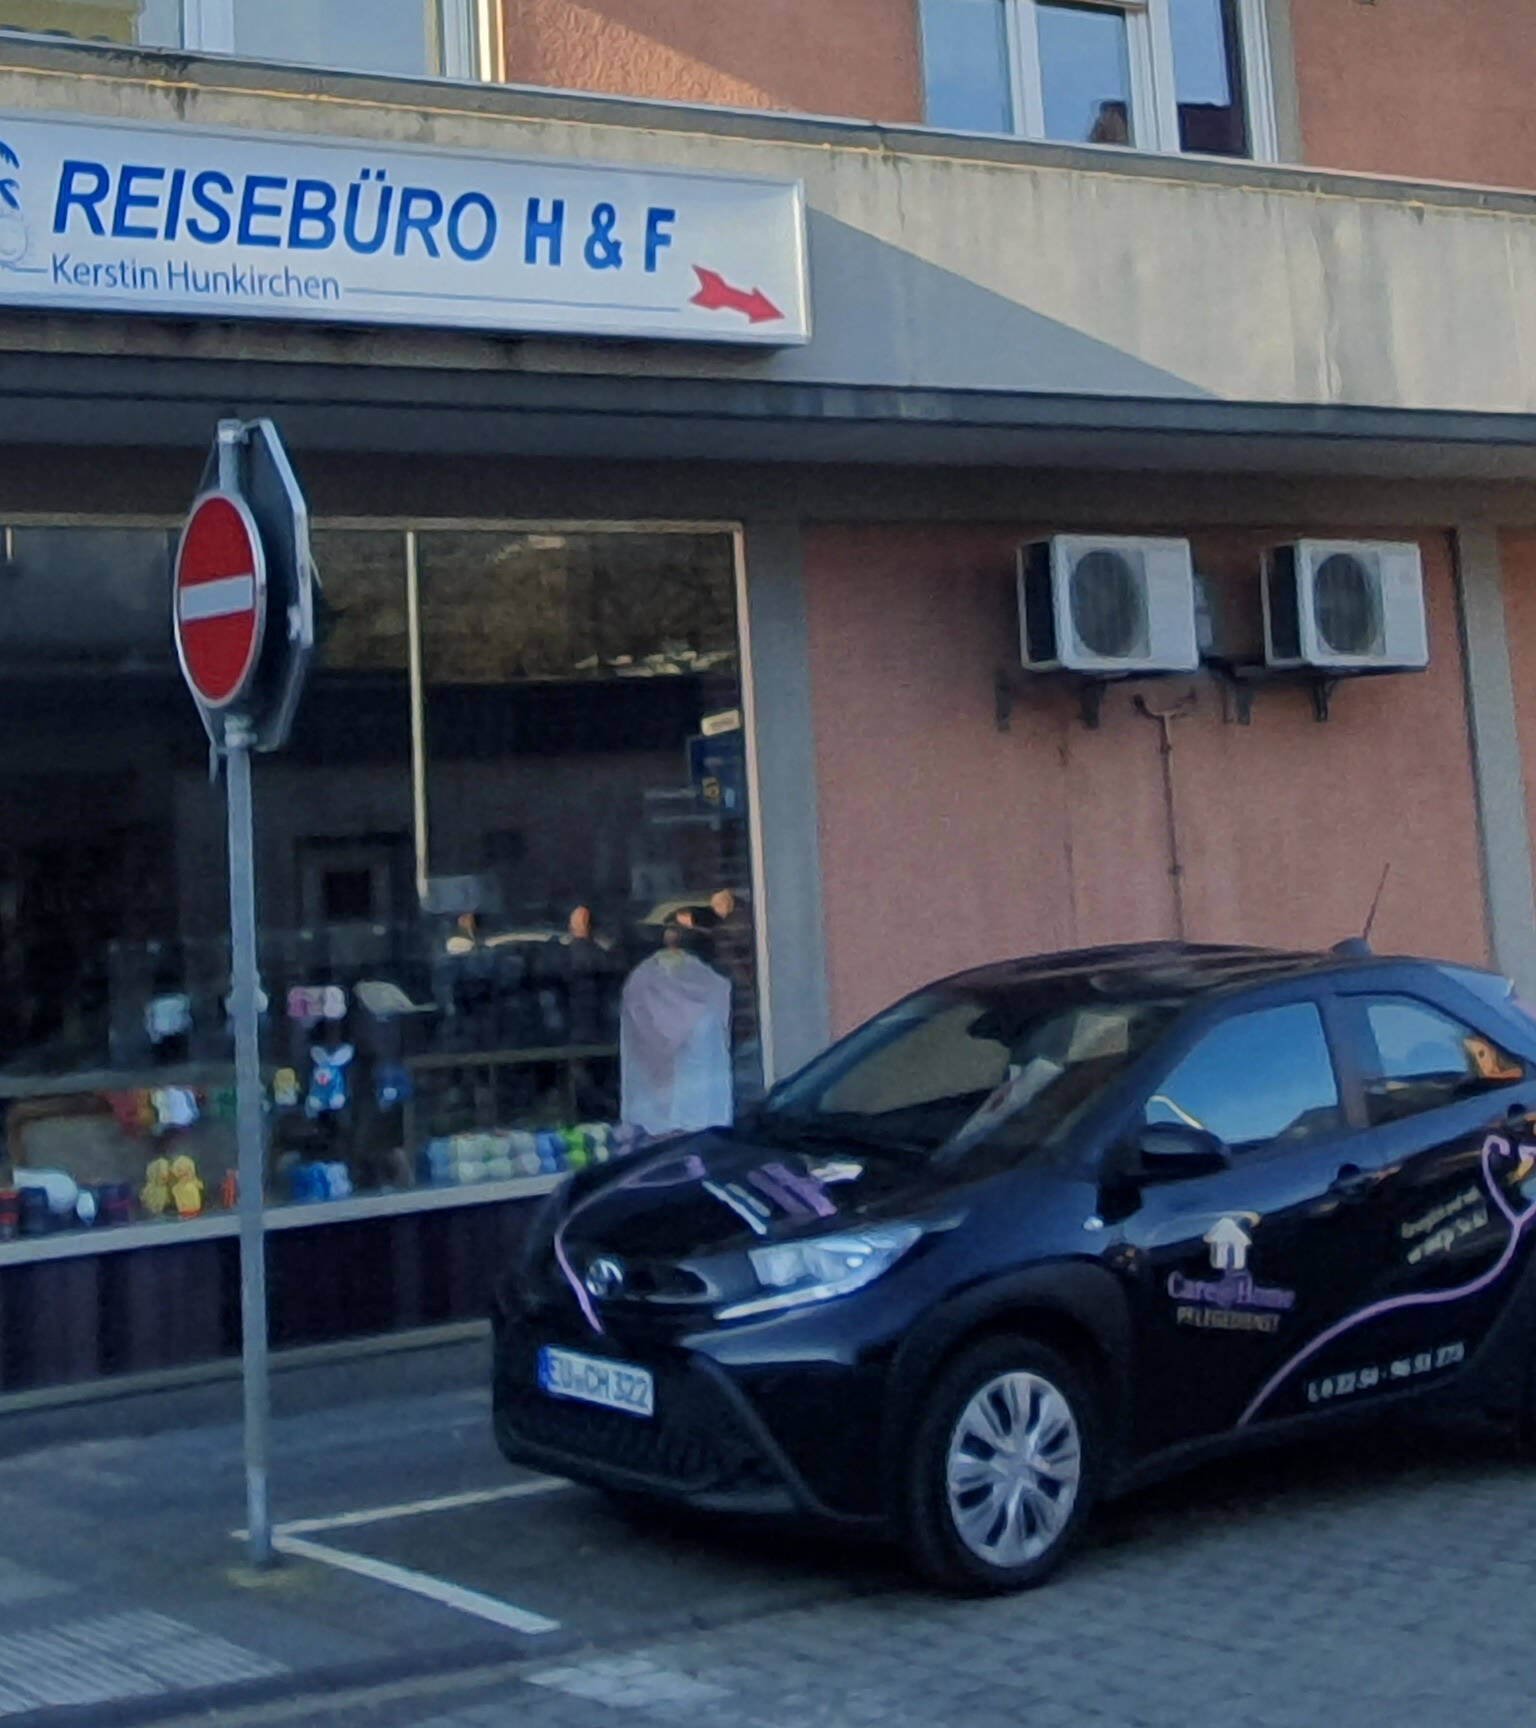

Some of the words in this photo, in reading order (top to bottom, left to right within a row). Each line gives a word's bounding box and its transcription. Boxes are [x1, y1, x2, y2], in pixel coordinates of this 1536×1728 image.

[52, 159, 497, 262] REISEBÜRO
[524, 197, 564, 266] H
[583, 202, 623, 270] &
[644, 206, 676, 273] F
[51, 252, 159, 290] Kerstin
[167, 259, 341, 301] Hunkirchen
